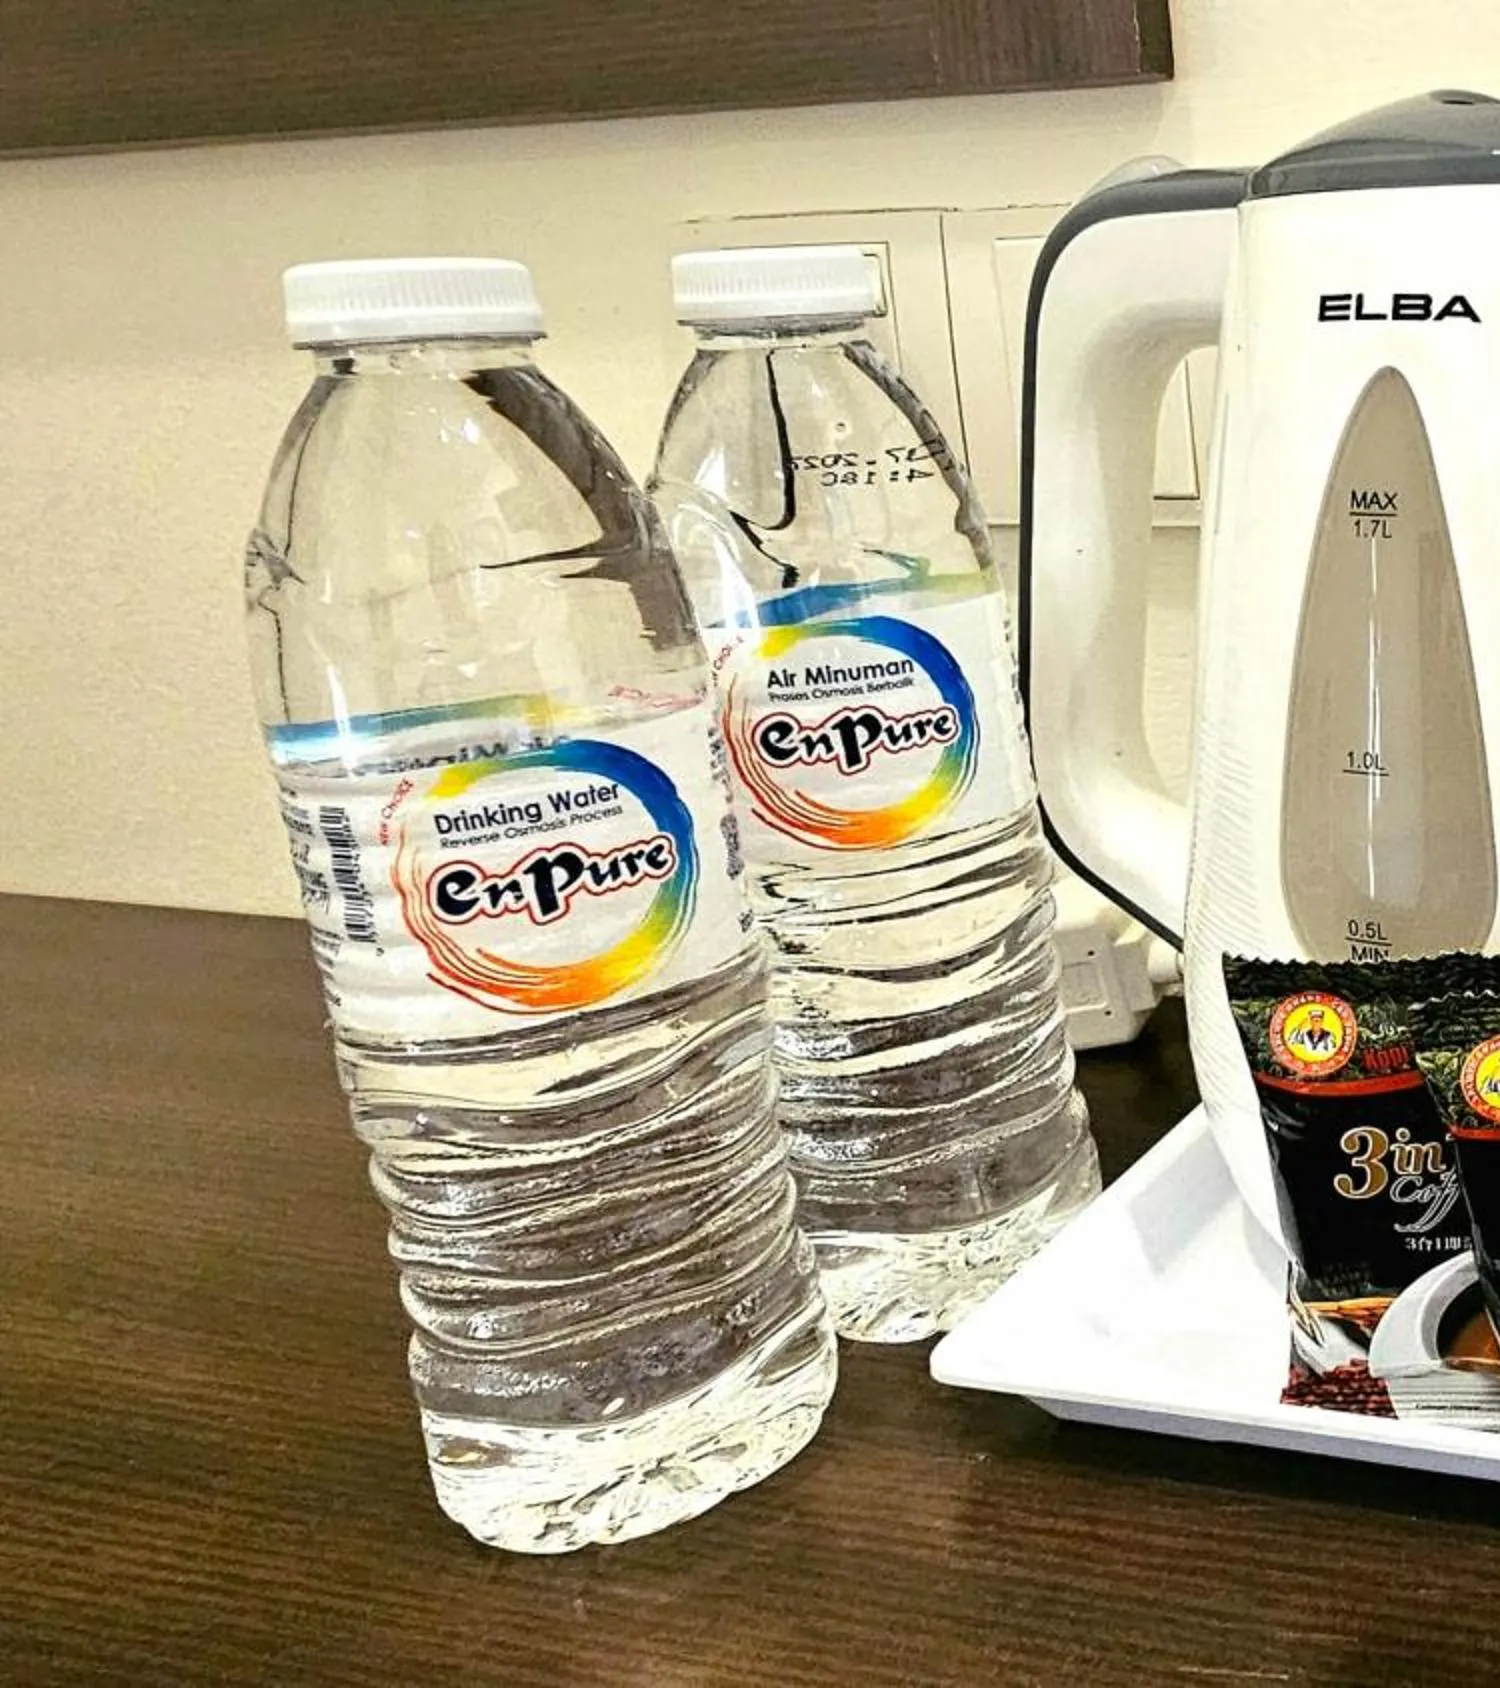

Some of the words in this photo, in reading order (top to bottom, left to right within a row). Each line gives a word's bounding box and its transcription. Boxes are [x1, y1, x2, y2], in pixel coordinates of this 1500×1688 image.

[1318, 293, 1482, 323] ELBA
[1350, 489, 1398, 511] MAX
[1353, 518, 1393, 540] 1.7L
[767, 668, 797, 689] Air
[805, 659, 915, 685] Minuman
[812, 685, 864, 699] Osmosis
[1347, 750, 1387, 771] 1.0L
[433, 801, 543, 835] Drinking
[547, 783, 620, 813] Water
[439, 831, 500, 849] Reverse
[503, 819, 567, 839] Osmosis
[569, 804, 624, 825] Process
[1348, 919, 1389, 941] 0.5L
